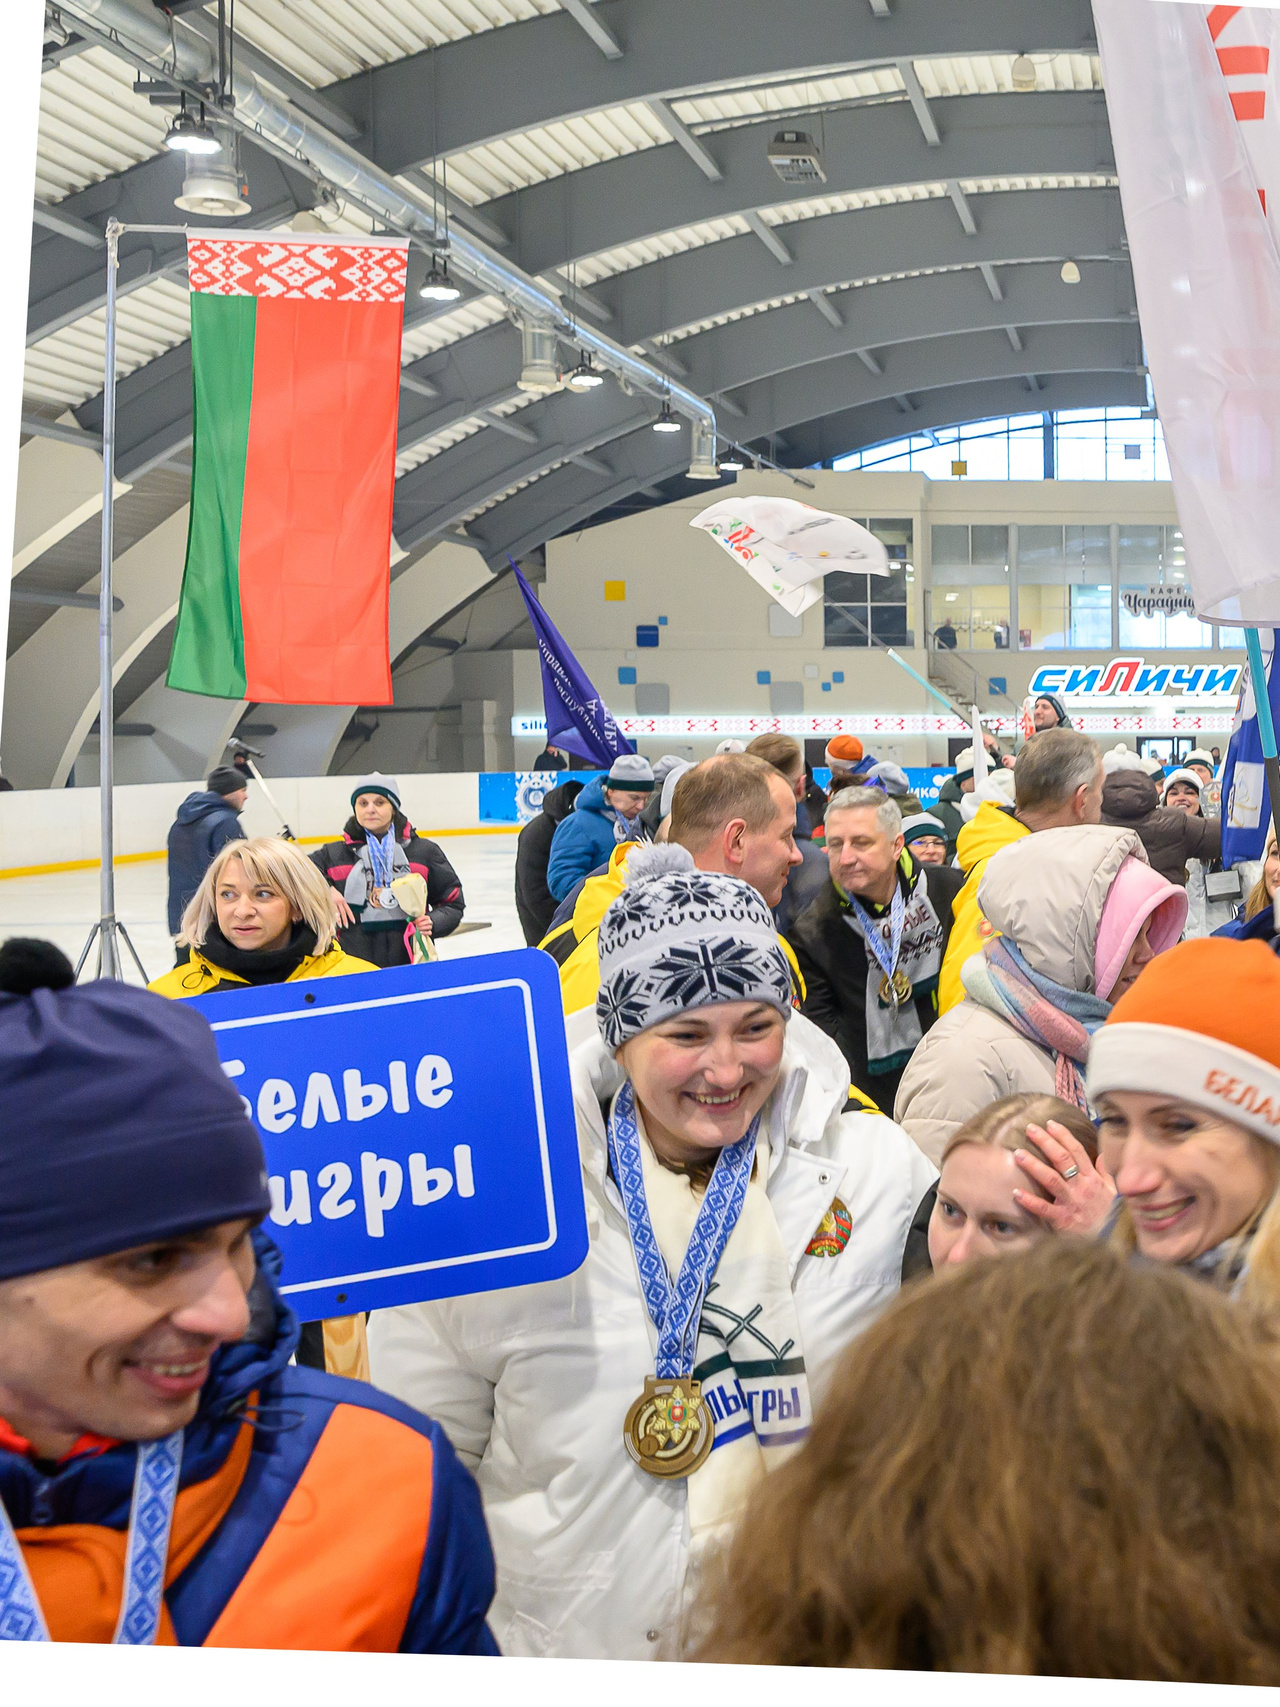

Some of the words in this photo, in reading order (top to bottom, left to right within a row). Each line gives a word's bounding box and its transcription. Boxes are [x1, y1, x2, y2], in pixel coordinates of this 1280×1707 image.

[1150, 587, 1182, 595] КАФЕ
[268, 1144, 475, 1238] игры
[747, 1387, 800, 1422] ГРЫ
